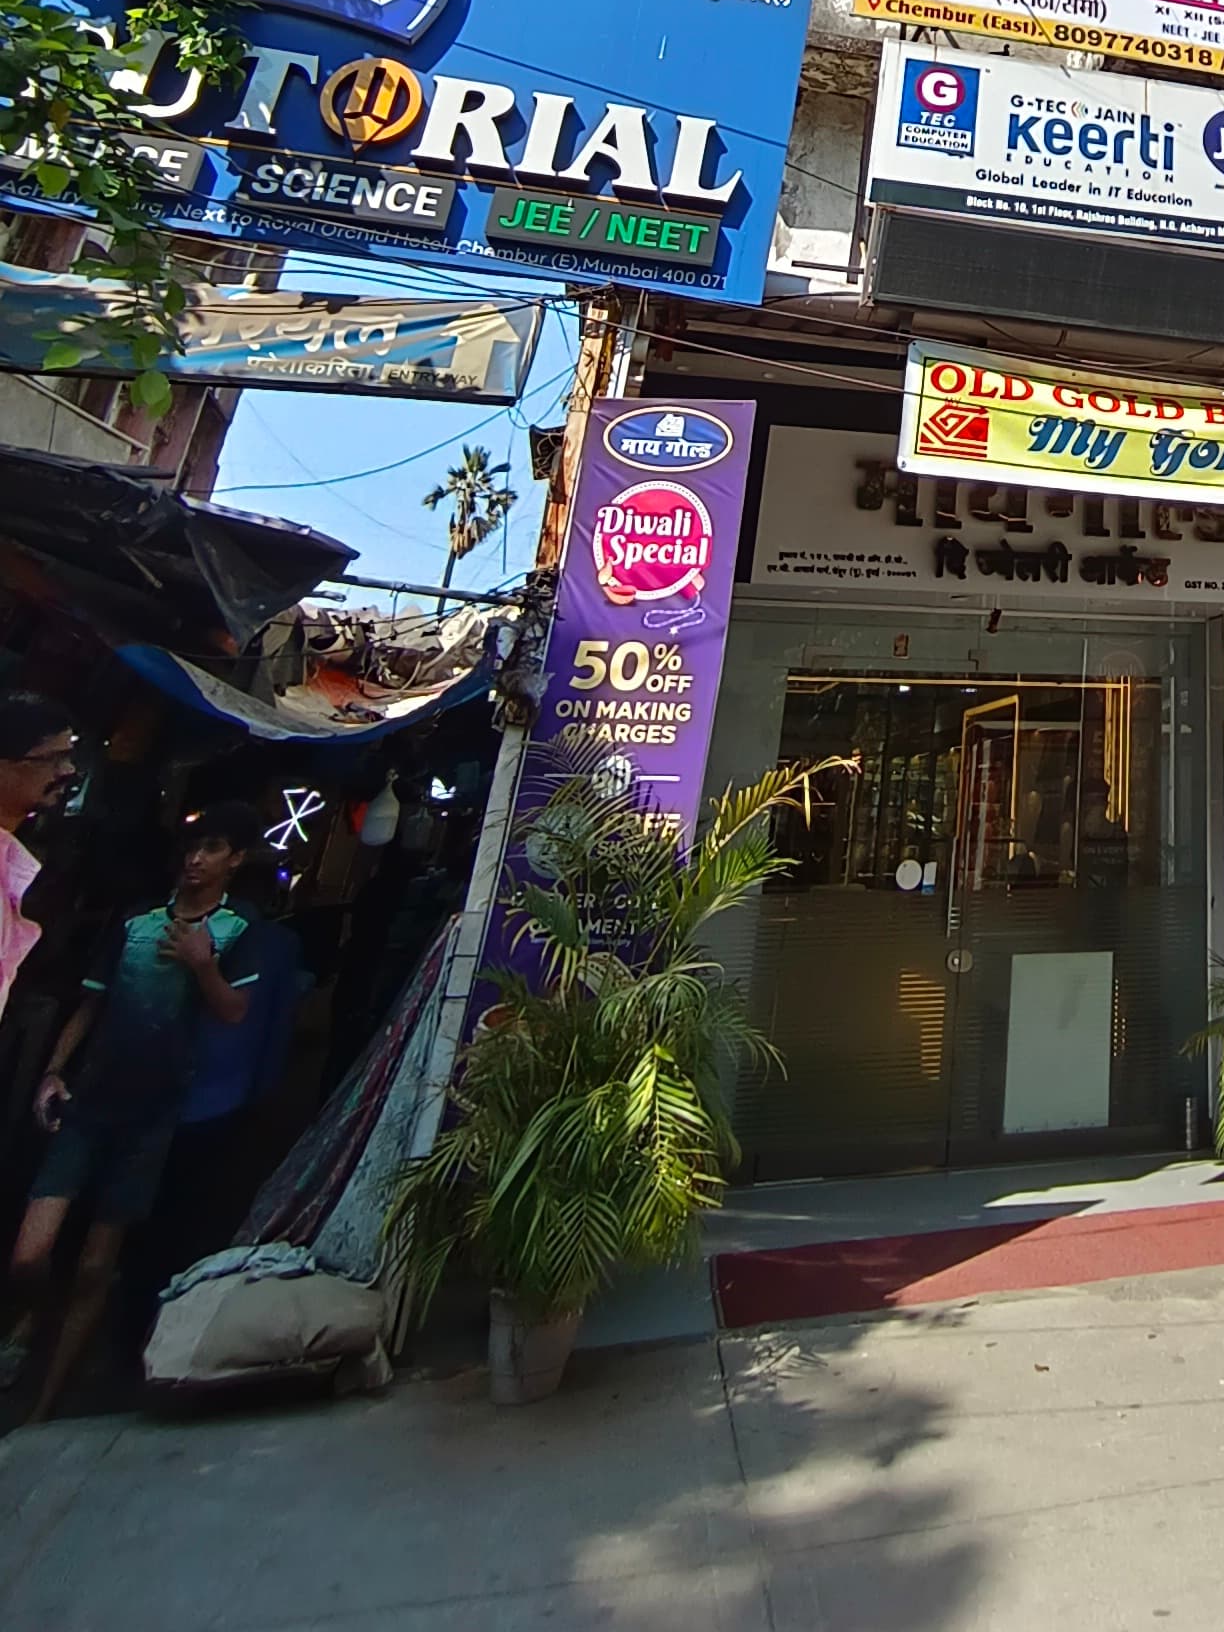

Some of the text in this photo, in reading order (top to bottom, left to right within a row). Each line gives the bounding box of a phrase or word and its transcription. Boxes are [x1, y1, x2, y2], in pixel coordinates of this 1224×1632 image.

[1053, 23, 1213, 67] 8097740318
[20, 18, 744, 204] UTORIAL
[919, 111, 957, 128] TEC
[1010, 94, 1136, 126] G-TEC JAIN
[903, 134, 969, 150] EDUCATION
[904, 124, 968, 140] COMPUTER
[250, 161, 444, 219] SCIENCE
[975, 168, 1025, 187] Global
[1032, 175, 1082, 194] Leader
[1088, 181, 1102, 196] in
[1108, 184, 1123, 198] IT
[1126, 186, 1193, 208] Education
[499, 198, 572, 236] JEE
[605, 214, 711, 255] NEET
[172, 203, 227, 225] Next
[231, 209, 253, 227] to
[456, 237, 546, 267] Chembur
[662, 267, 697, 287] 400
[700, 270, 728, 291] 071
[929, 361, 1035, 402] OLD
[1051, 382, 1186, 422] GOLD
[1028, 413, 1129, 472] My
[597, 505, 692, 537] Diwali
[608, 536, 710, 570] Special
[1184, 580, 1203, 590] GST
[645, 674, 694, 695] OFF
[555, 699, 692, 722] ON MAKING
